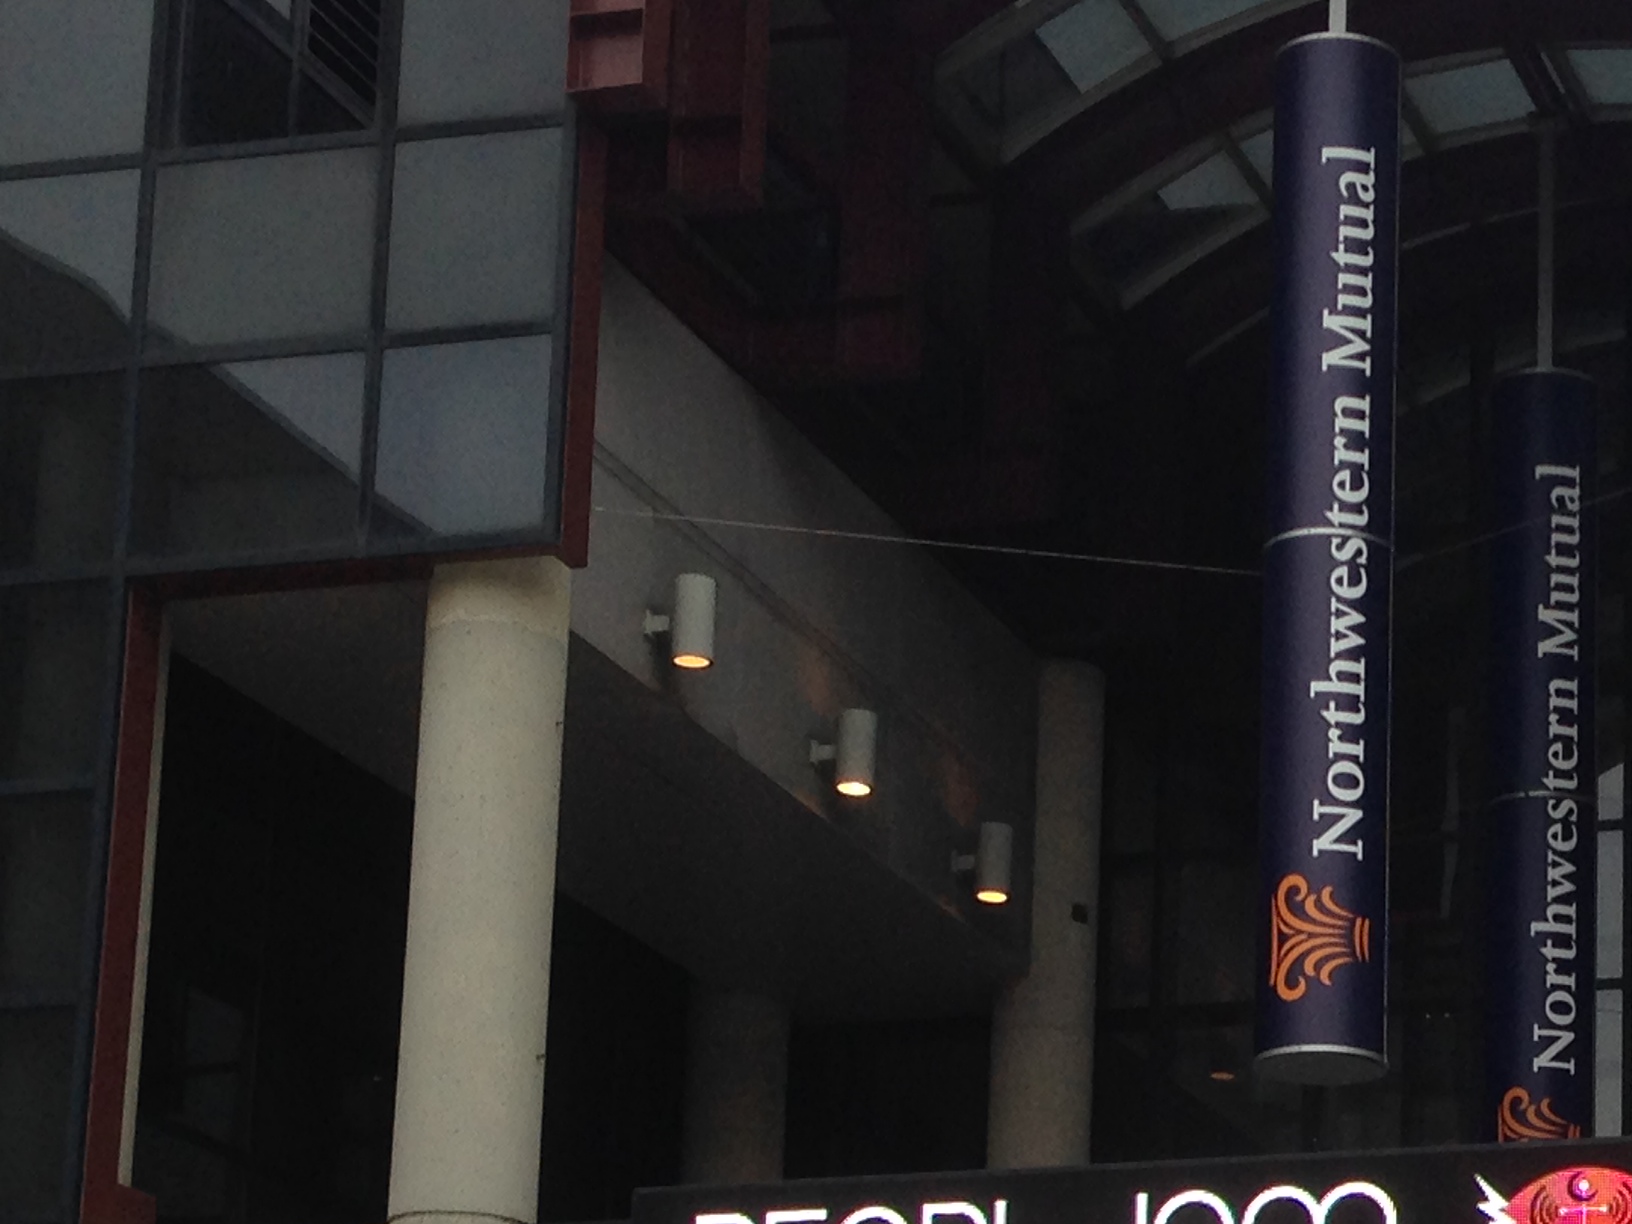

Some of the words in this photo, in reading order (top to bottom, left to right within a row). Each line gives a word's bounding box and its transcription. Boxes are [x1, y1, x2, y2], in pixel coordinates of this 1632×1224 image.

[1321, 146, 1375, 377] Mutual
[1309, 394, 1371, 861] Northwestern
[1535, 465, 1580, 661] Mutual
[1532, 679, 1579, 1075] Northwestern
